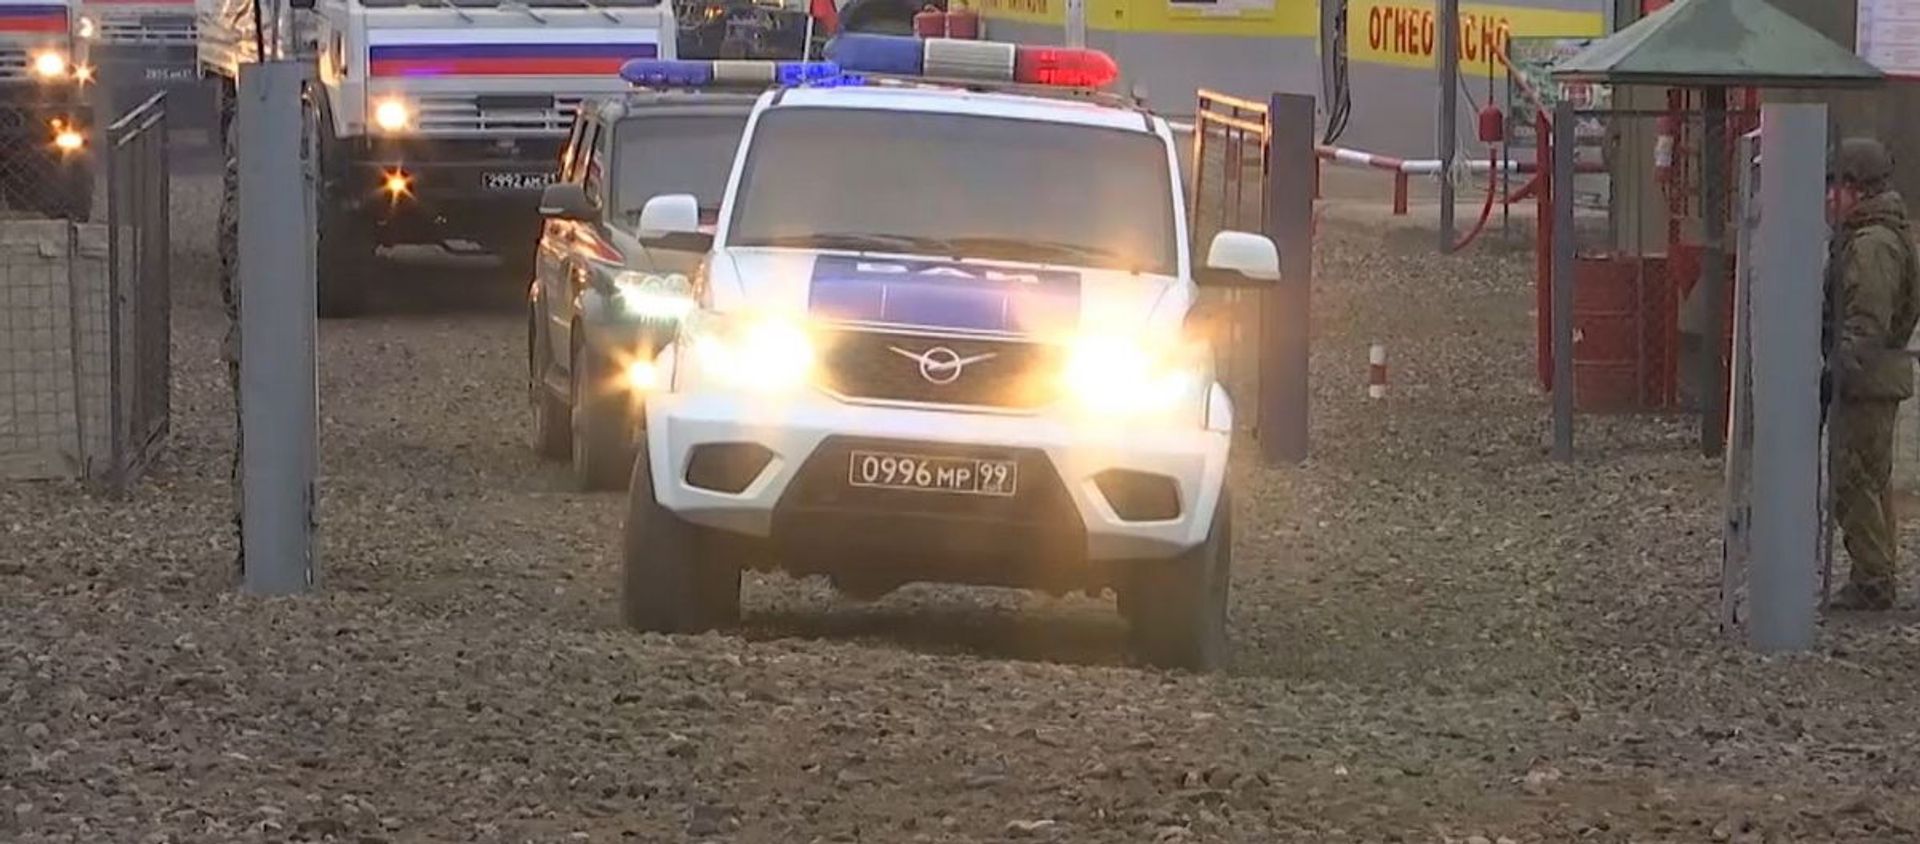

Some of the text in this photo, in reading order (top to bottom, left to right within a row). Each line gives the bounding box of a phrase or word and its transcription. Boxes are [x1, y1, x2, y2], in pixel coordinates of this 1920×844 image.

[1369, 6, 1510, 65] ОГНЕОСНО
[489, 173, 521, 189] 2992
[524, 176, 542, 189] АМ
[862, 456, 1008, 488] 0996 МР 99
